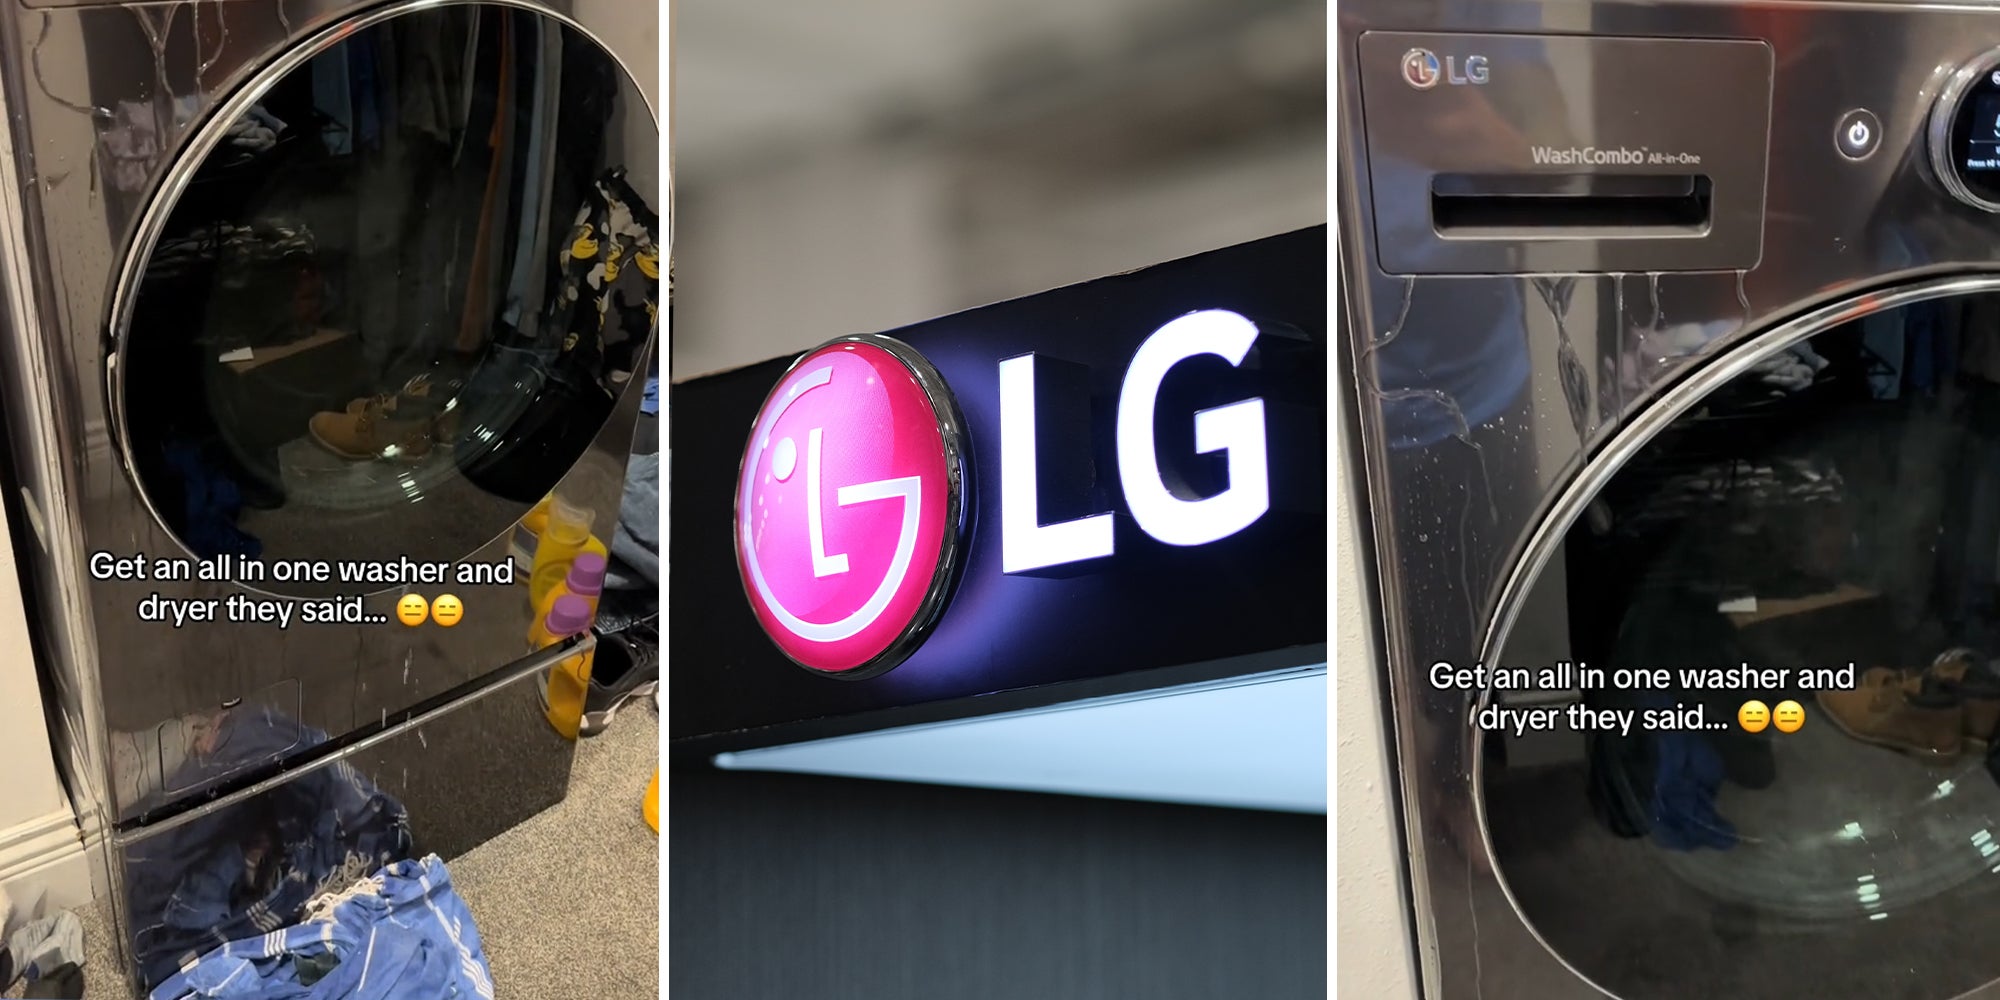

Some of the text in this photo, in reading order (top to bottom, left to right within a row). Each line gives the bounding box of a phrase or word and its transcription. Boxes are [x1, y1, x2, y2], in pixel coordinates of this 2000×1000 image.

[1446, 55, 1489, 85] LG
[1648, 152, 1701, 164] All-in-One
[999, 308, 1270, 575] LG
